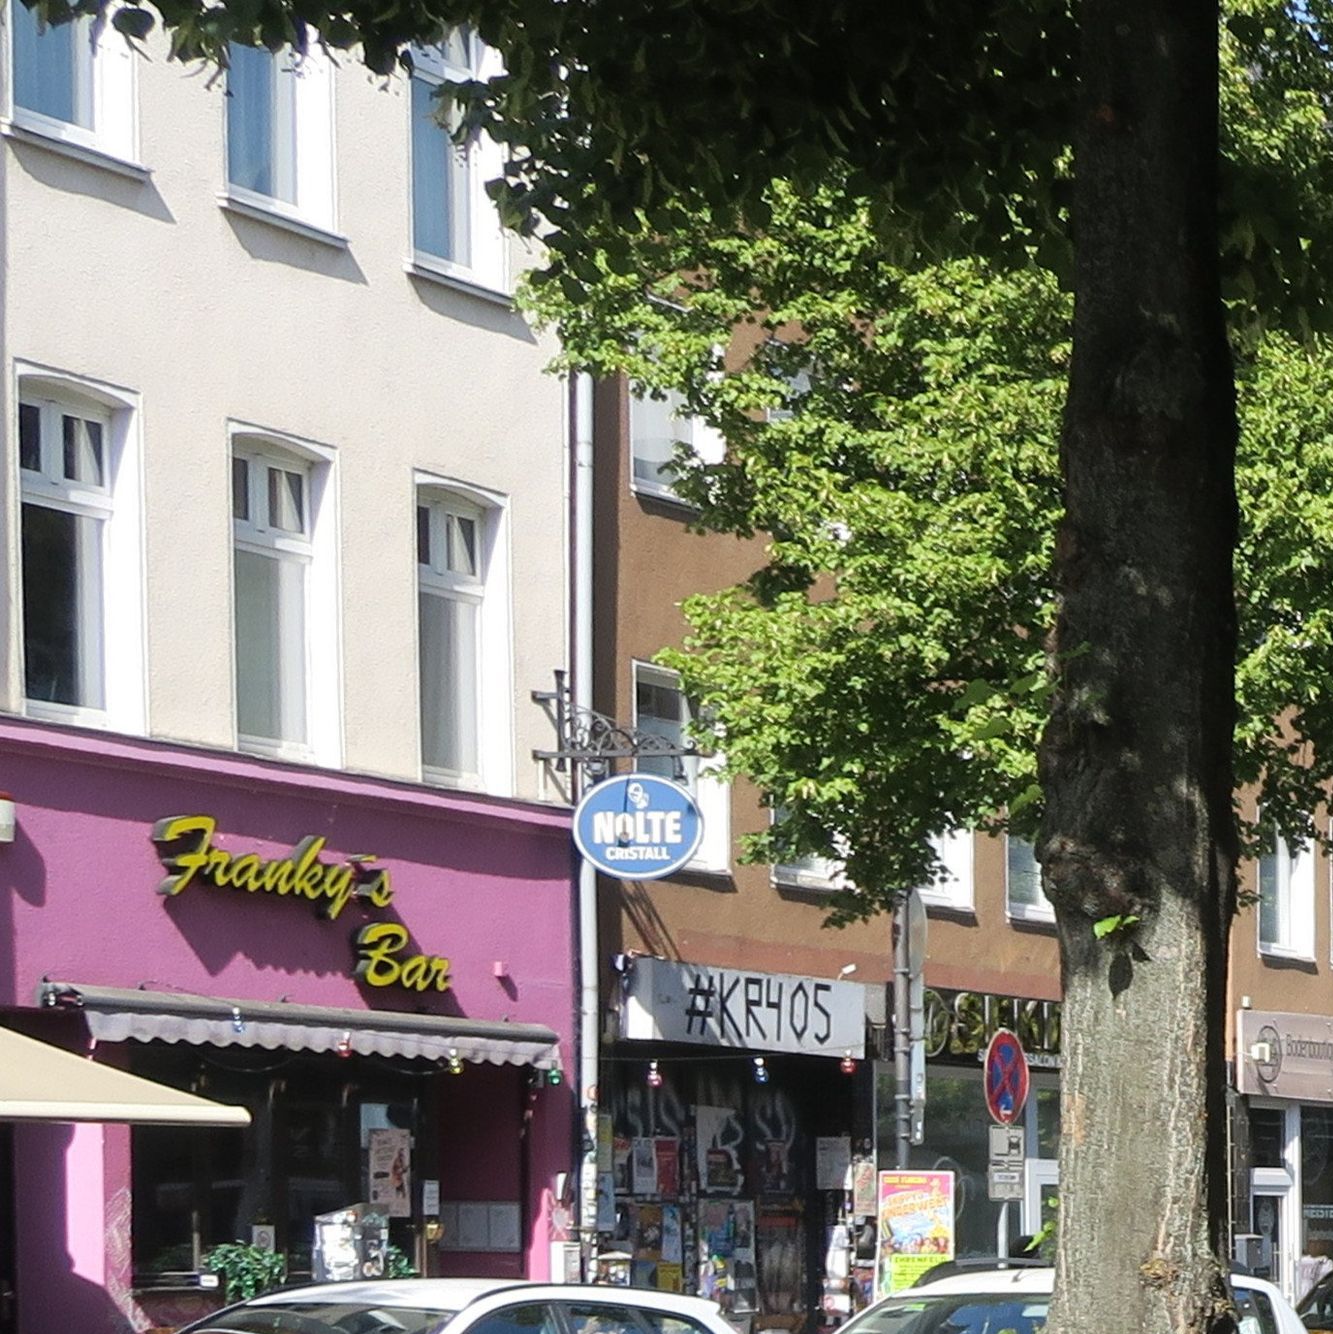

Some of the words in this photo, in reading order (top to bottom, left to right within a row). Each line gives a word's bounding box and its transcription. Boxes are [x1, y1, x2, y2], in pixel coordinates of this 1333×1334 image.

[593, 810, 682, 845] NOLTE
[605, 845, 671, 860] CRISTALL
[356, 922, 450, 991] Bar
